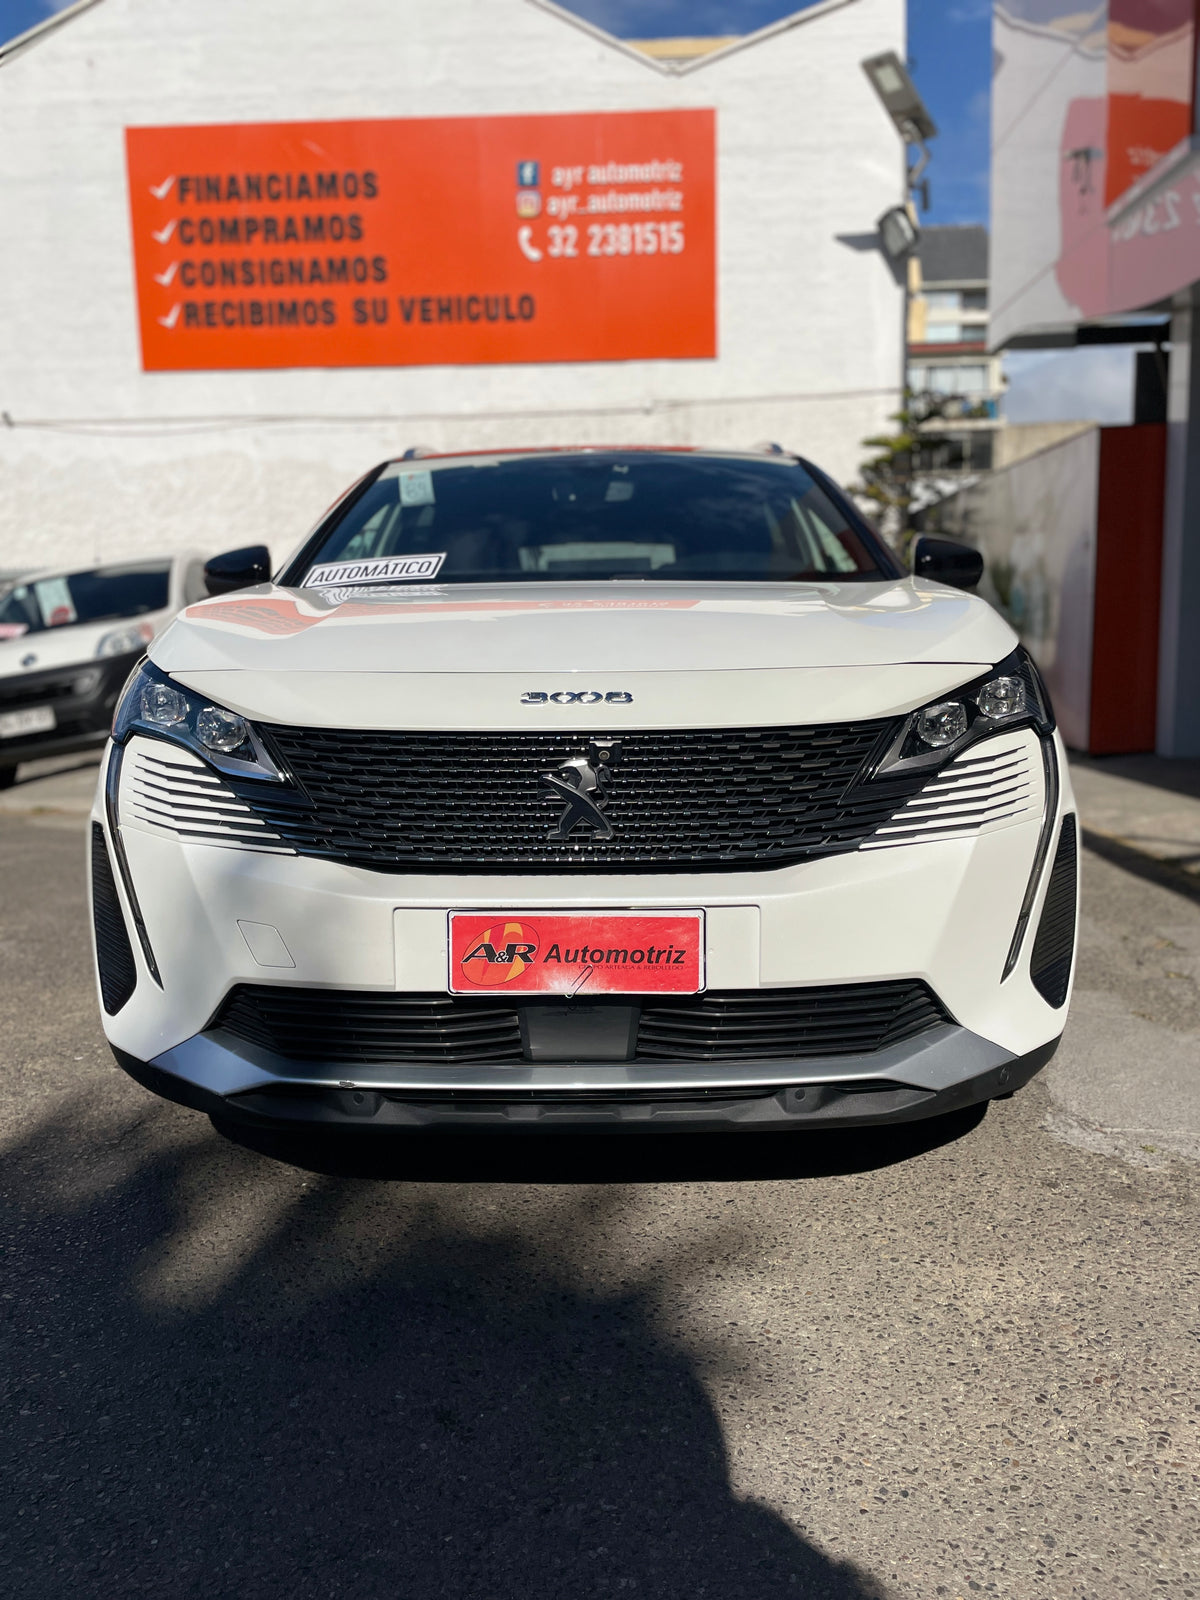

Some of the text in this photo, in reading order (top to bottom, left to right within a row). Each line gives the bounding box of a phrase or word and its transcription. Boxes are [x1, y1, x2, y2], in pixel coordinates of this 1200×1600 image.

[177, 171, 378, 203] FINANCIAMOS
[551, 165, 584, 191] ayr
[177, 213, 364, 245] COMPRAMOS
[547, 221, 685, 258] 32 2381515
[179, 256, 388, 288] CONSIGNAMOS
[183, 293, 536, 330] RECIBIMOS SU VEHICULO
[311, 560, 432, 584] AUTOMÁTICO
[519, 691, 634, 705] 3008
[461, 943, 686, 964] A&R Automotriz
